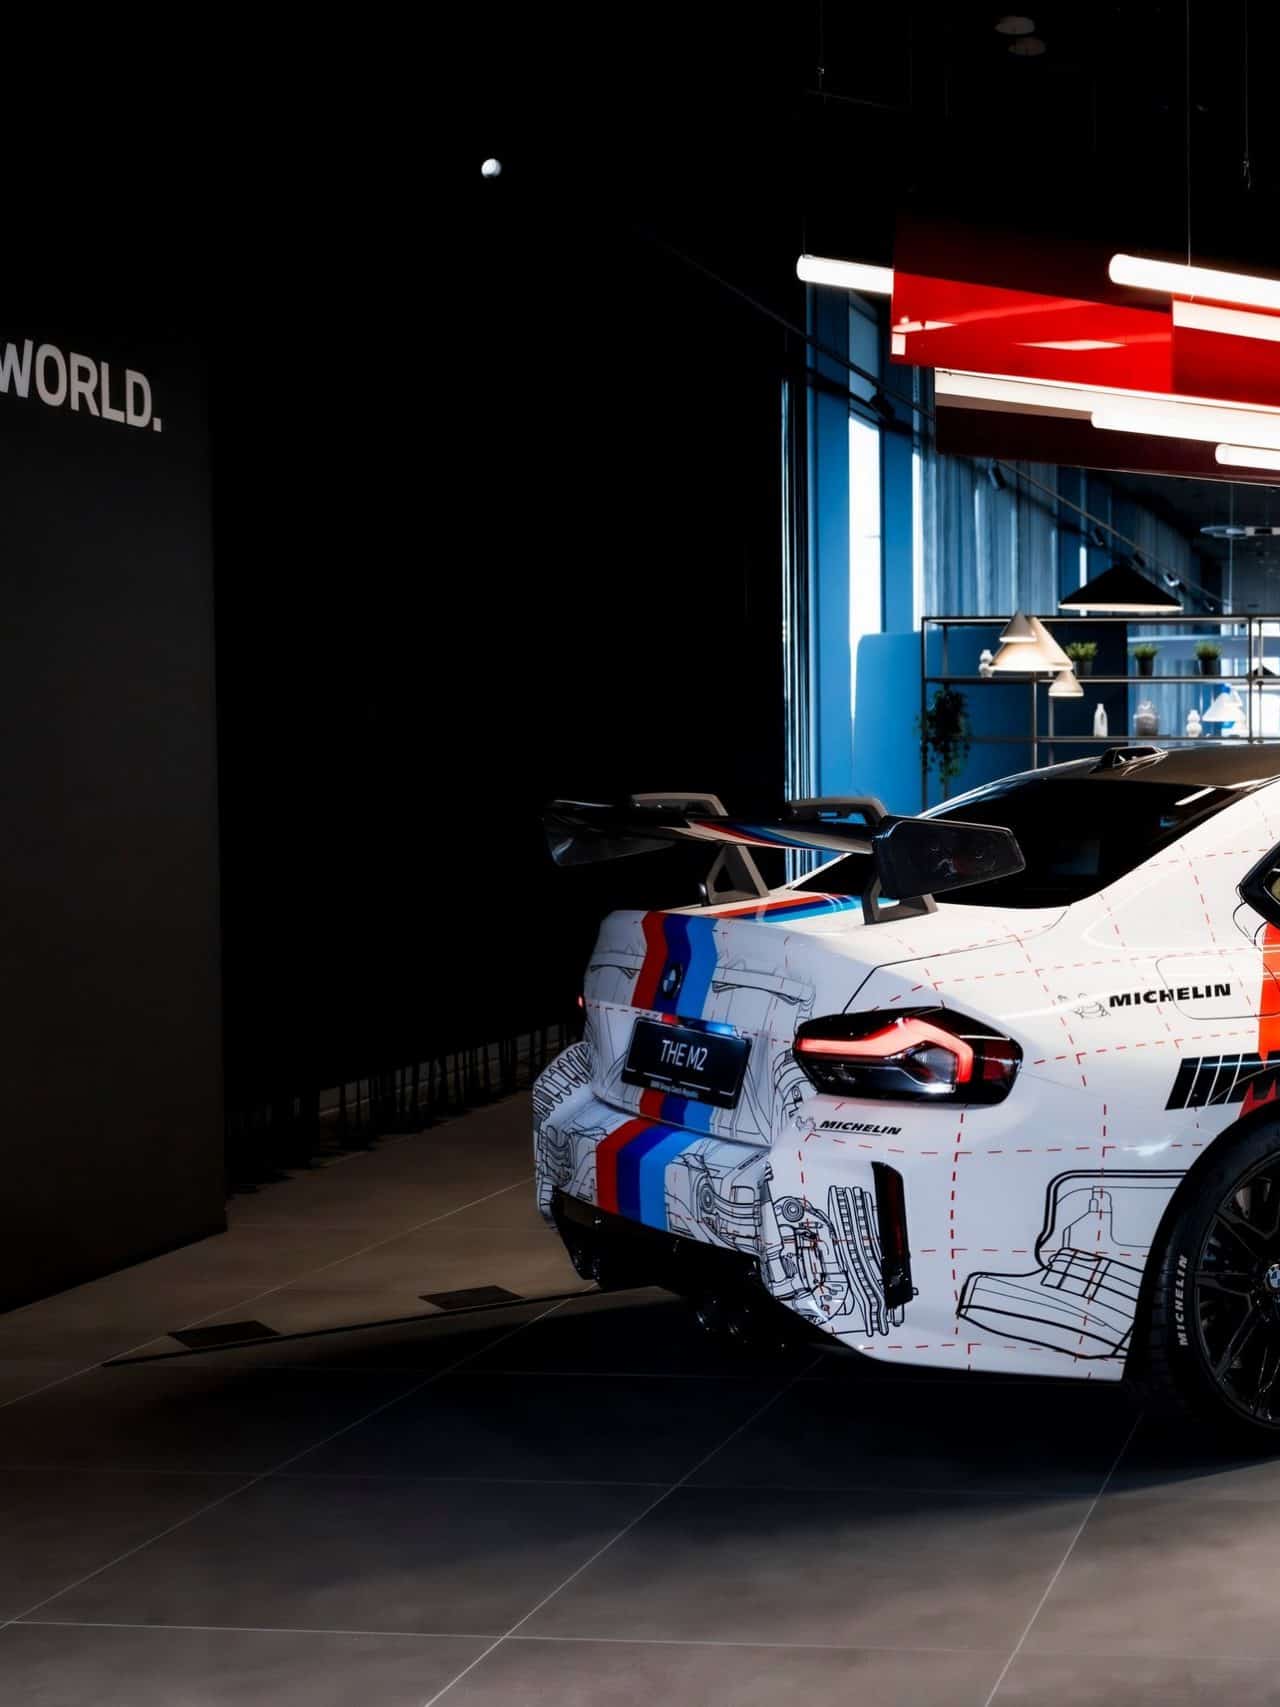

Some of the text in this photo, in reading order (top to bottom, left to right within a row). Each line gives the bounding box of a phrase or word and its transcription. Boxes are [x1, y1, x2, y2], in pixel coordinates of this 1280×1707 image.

[0, 339, 162, 432] WORLD.
[1109, 983, 1231, 1007] MICHELIN
[660, 1039, 708, 1071] THE M2
[819, 1120, 902, 1135] MICHELIN
[1175, 1255, 1188, 1346] MICHELIN
